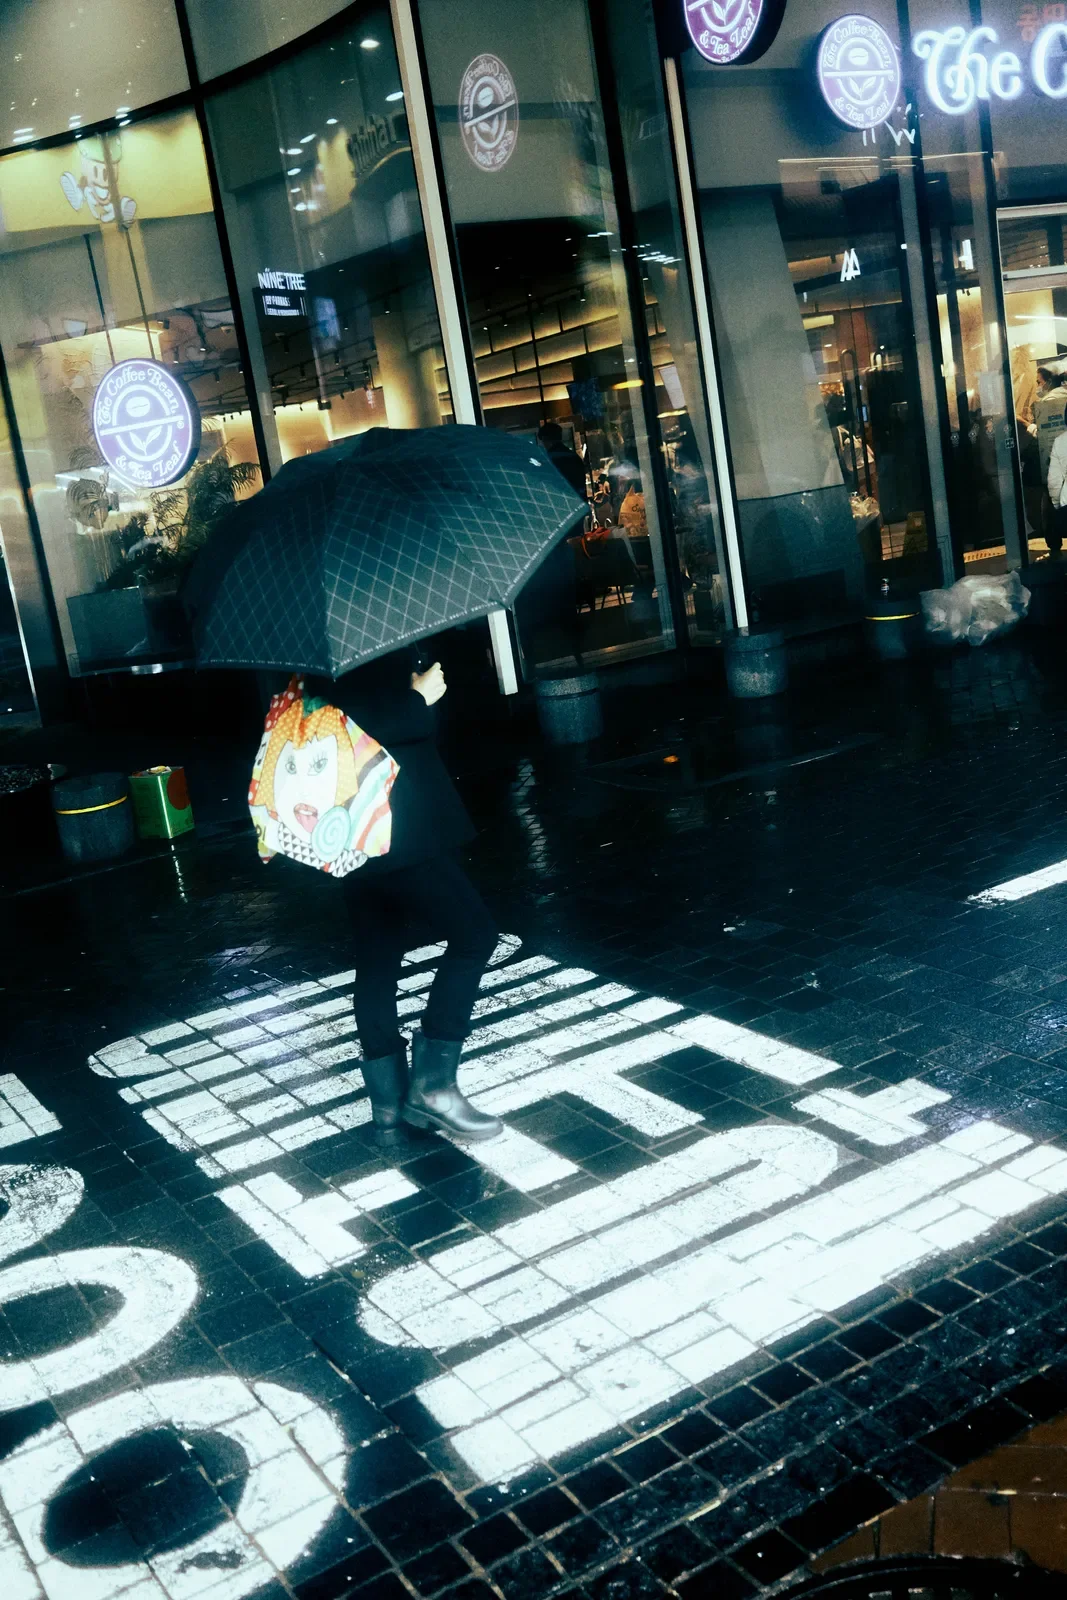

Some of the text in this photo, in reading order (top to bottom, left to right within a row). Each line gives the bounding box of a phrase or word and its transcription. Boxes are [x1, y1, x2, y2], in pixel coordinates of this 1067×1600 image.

[700, 0, 755, 55] & Tea Leaf
[823, 20, 893, 68] The Coffee Bean
[912, 26, 1023, 115] The
[835, 90, 890, 122] & Tea Leaf
[97, 366, 180, 427] The Coffee Bean
[115, 440, 183, 480] & Tea Leaf
